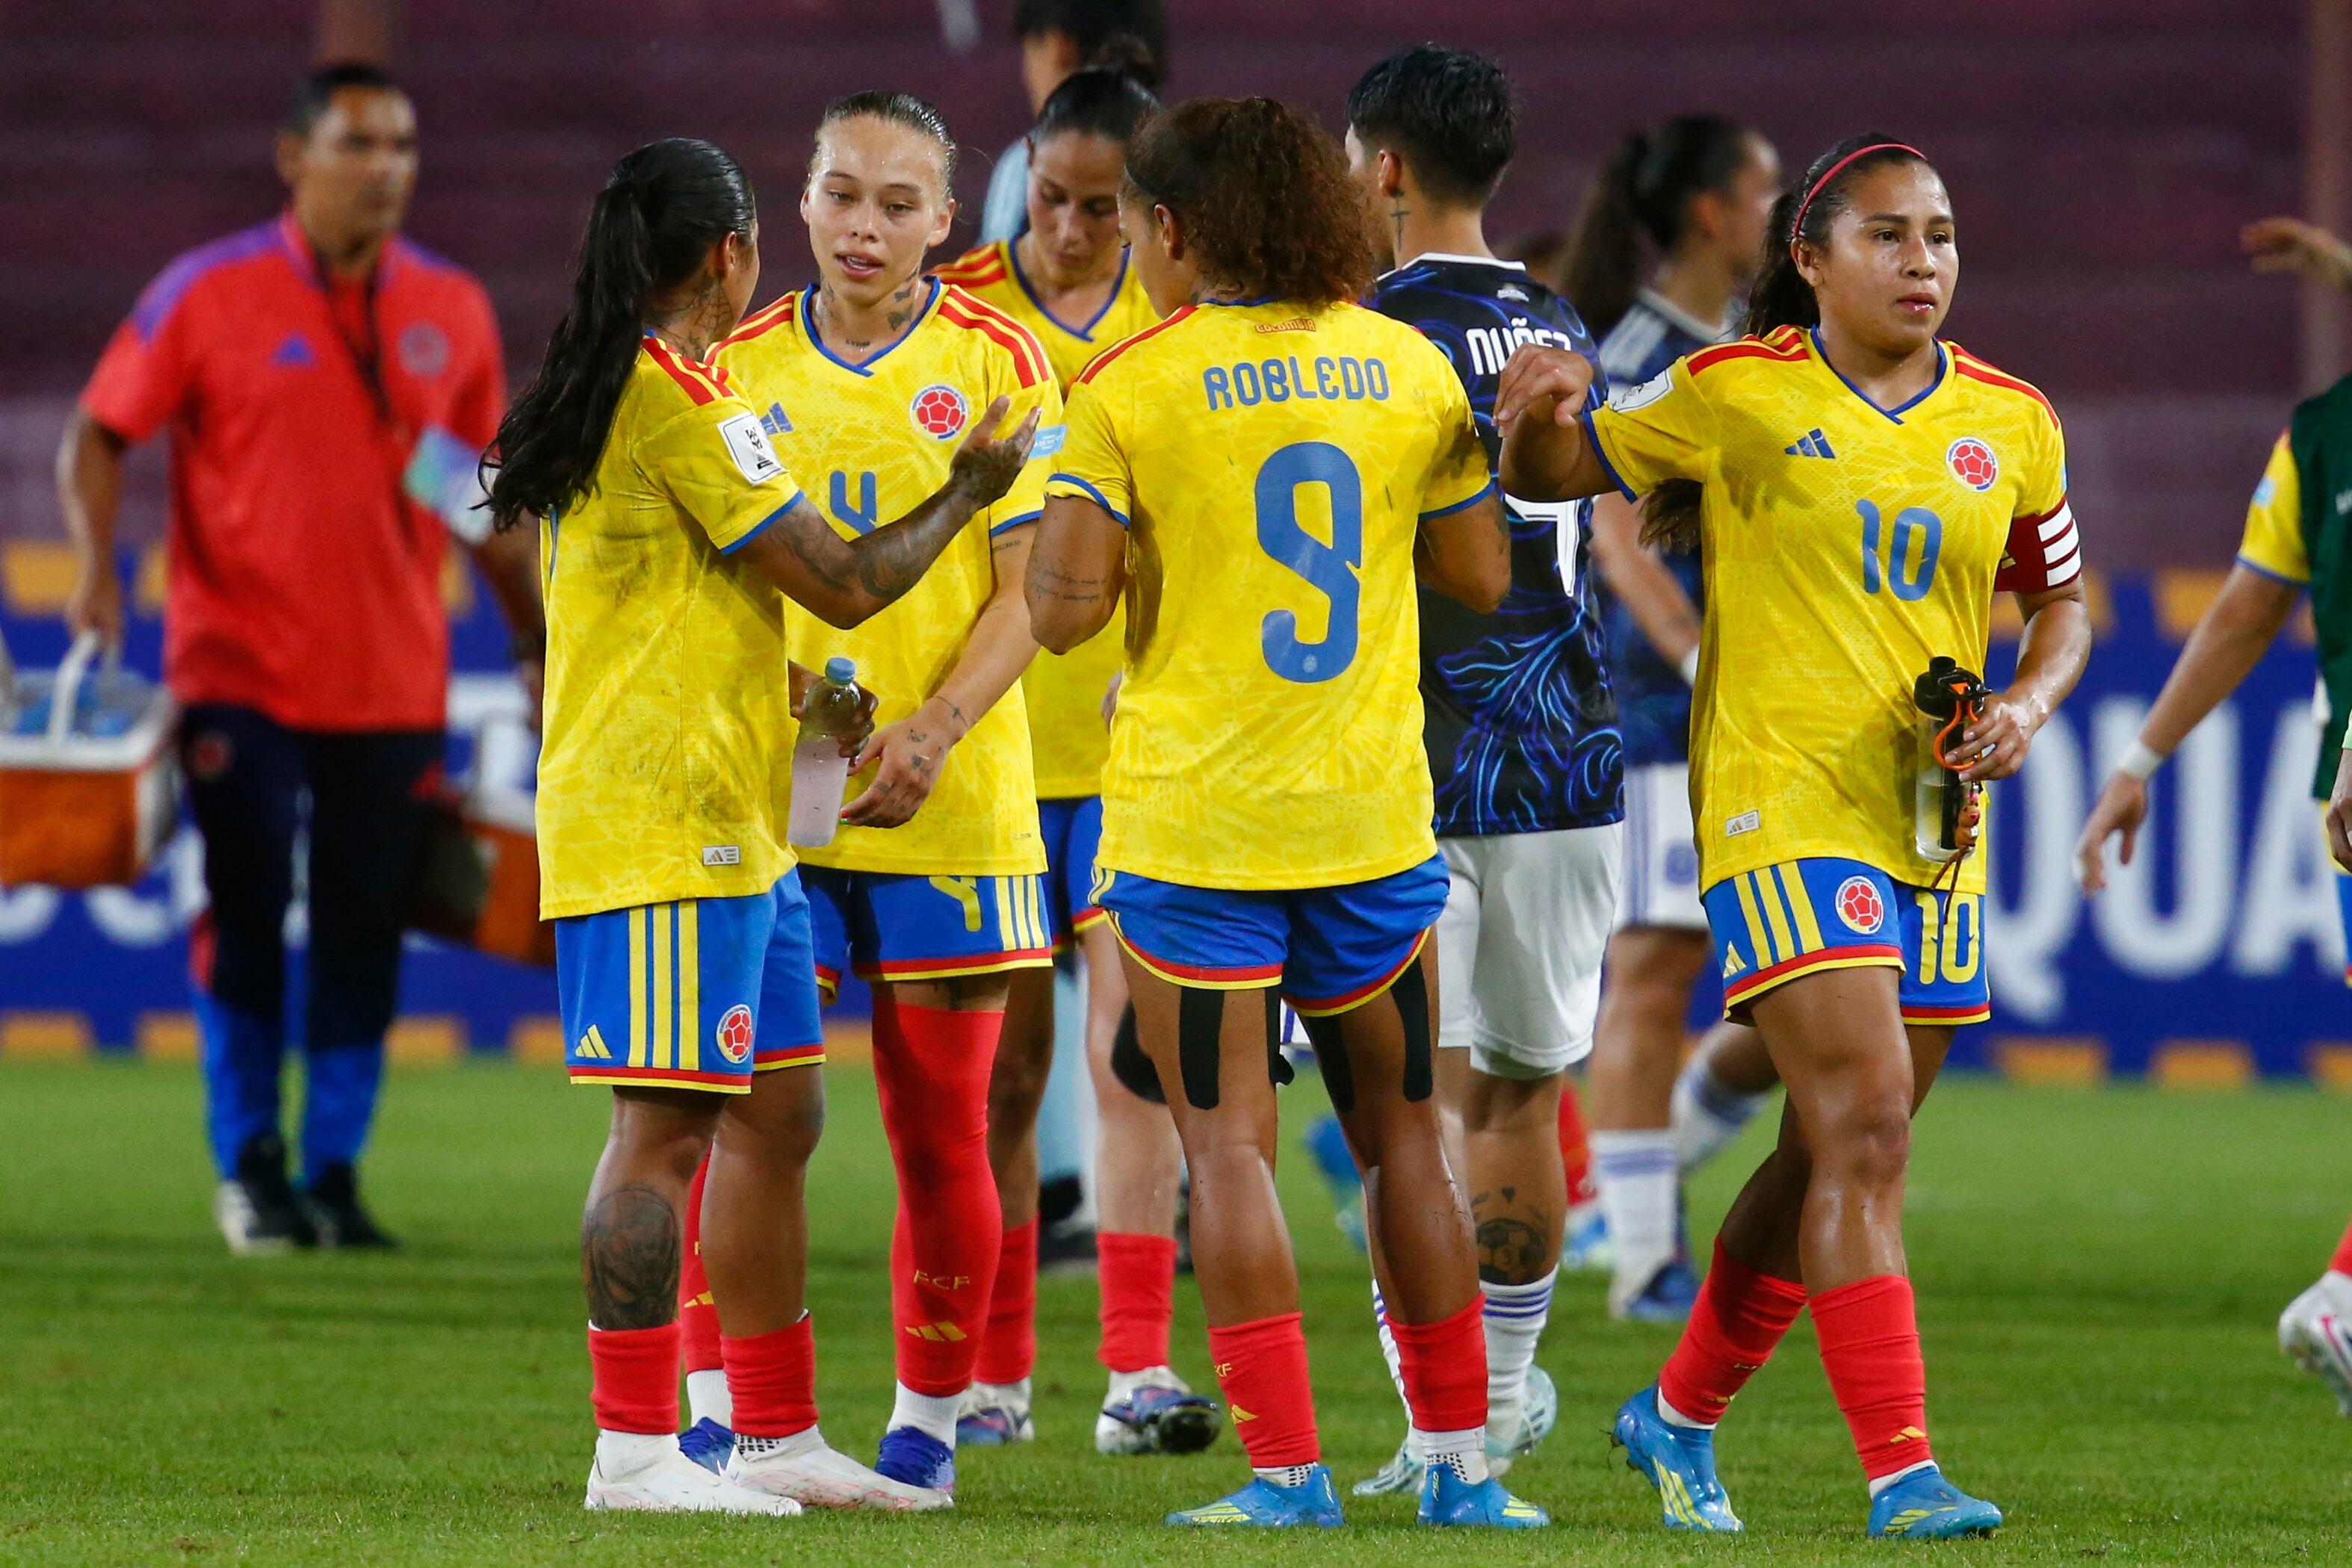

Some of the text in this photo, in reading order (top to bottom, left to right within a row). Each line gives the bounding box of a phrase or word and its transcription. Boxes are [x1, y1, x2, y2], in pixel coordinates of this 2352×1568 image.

[1255, 318, 1316, 333] COLOMBIA
[1204, 356, 1389, 410] ROBLEDO
[830, 471, 876, 535] 4
[1254, 441, 1361, 683] 9
[1856, 499, 1943, 601] 10
[1915, 891, 1980, 984] 10
[914, 1270, 970, 1290] FCF
[1214, 1363, 1233, 1378] CF
